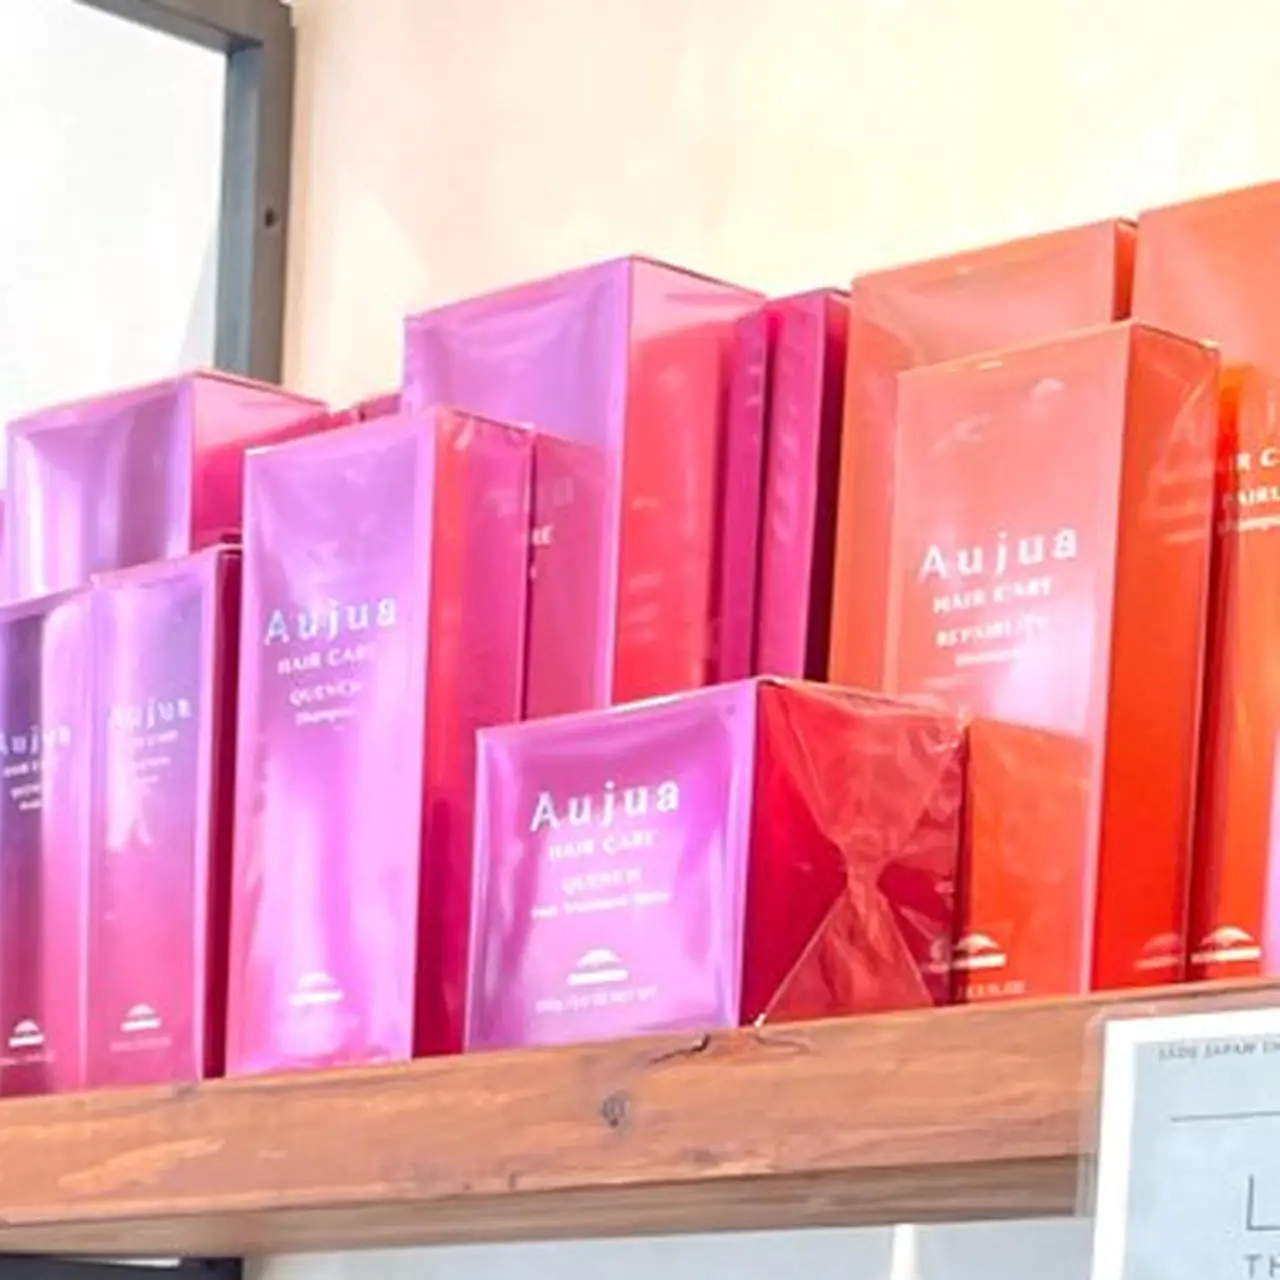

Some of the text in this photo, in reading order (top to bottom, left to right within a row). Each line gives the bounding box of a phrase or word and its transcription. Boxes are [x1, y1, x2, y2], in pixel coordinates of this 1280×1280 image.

[917, 526, 1079, 584] Aujua
[932, 588, 986, 615] HAIR
[263, 596, 398, 647] Aujua
[277, 651, 322, 676] HAIR
[107, 696, 191, 730] Aujua
[529, 780, 681, 833] Aujua
[548, 828, 657, 862] HAIR CARE
